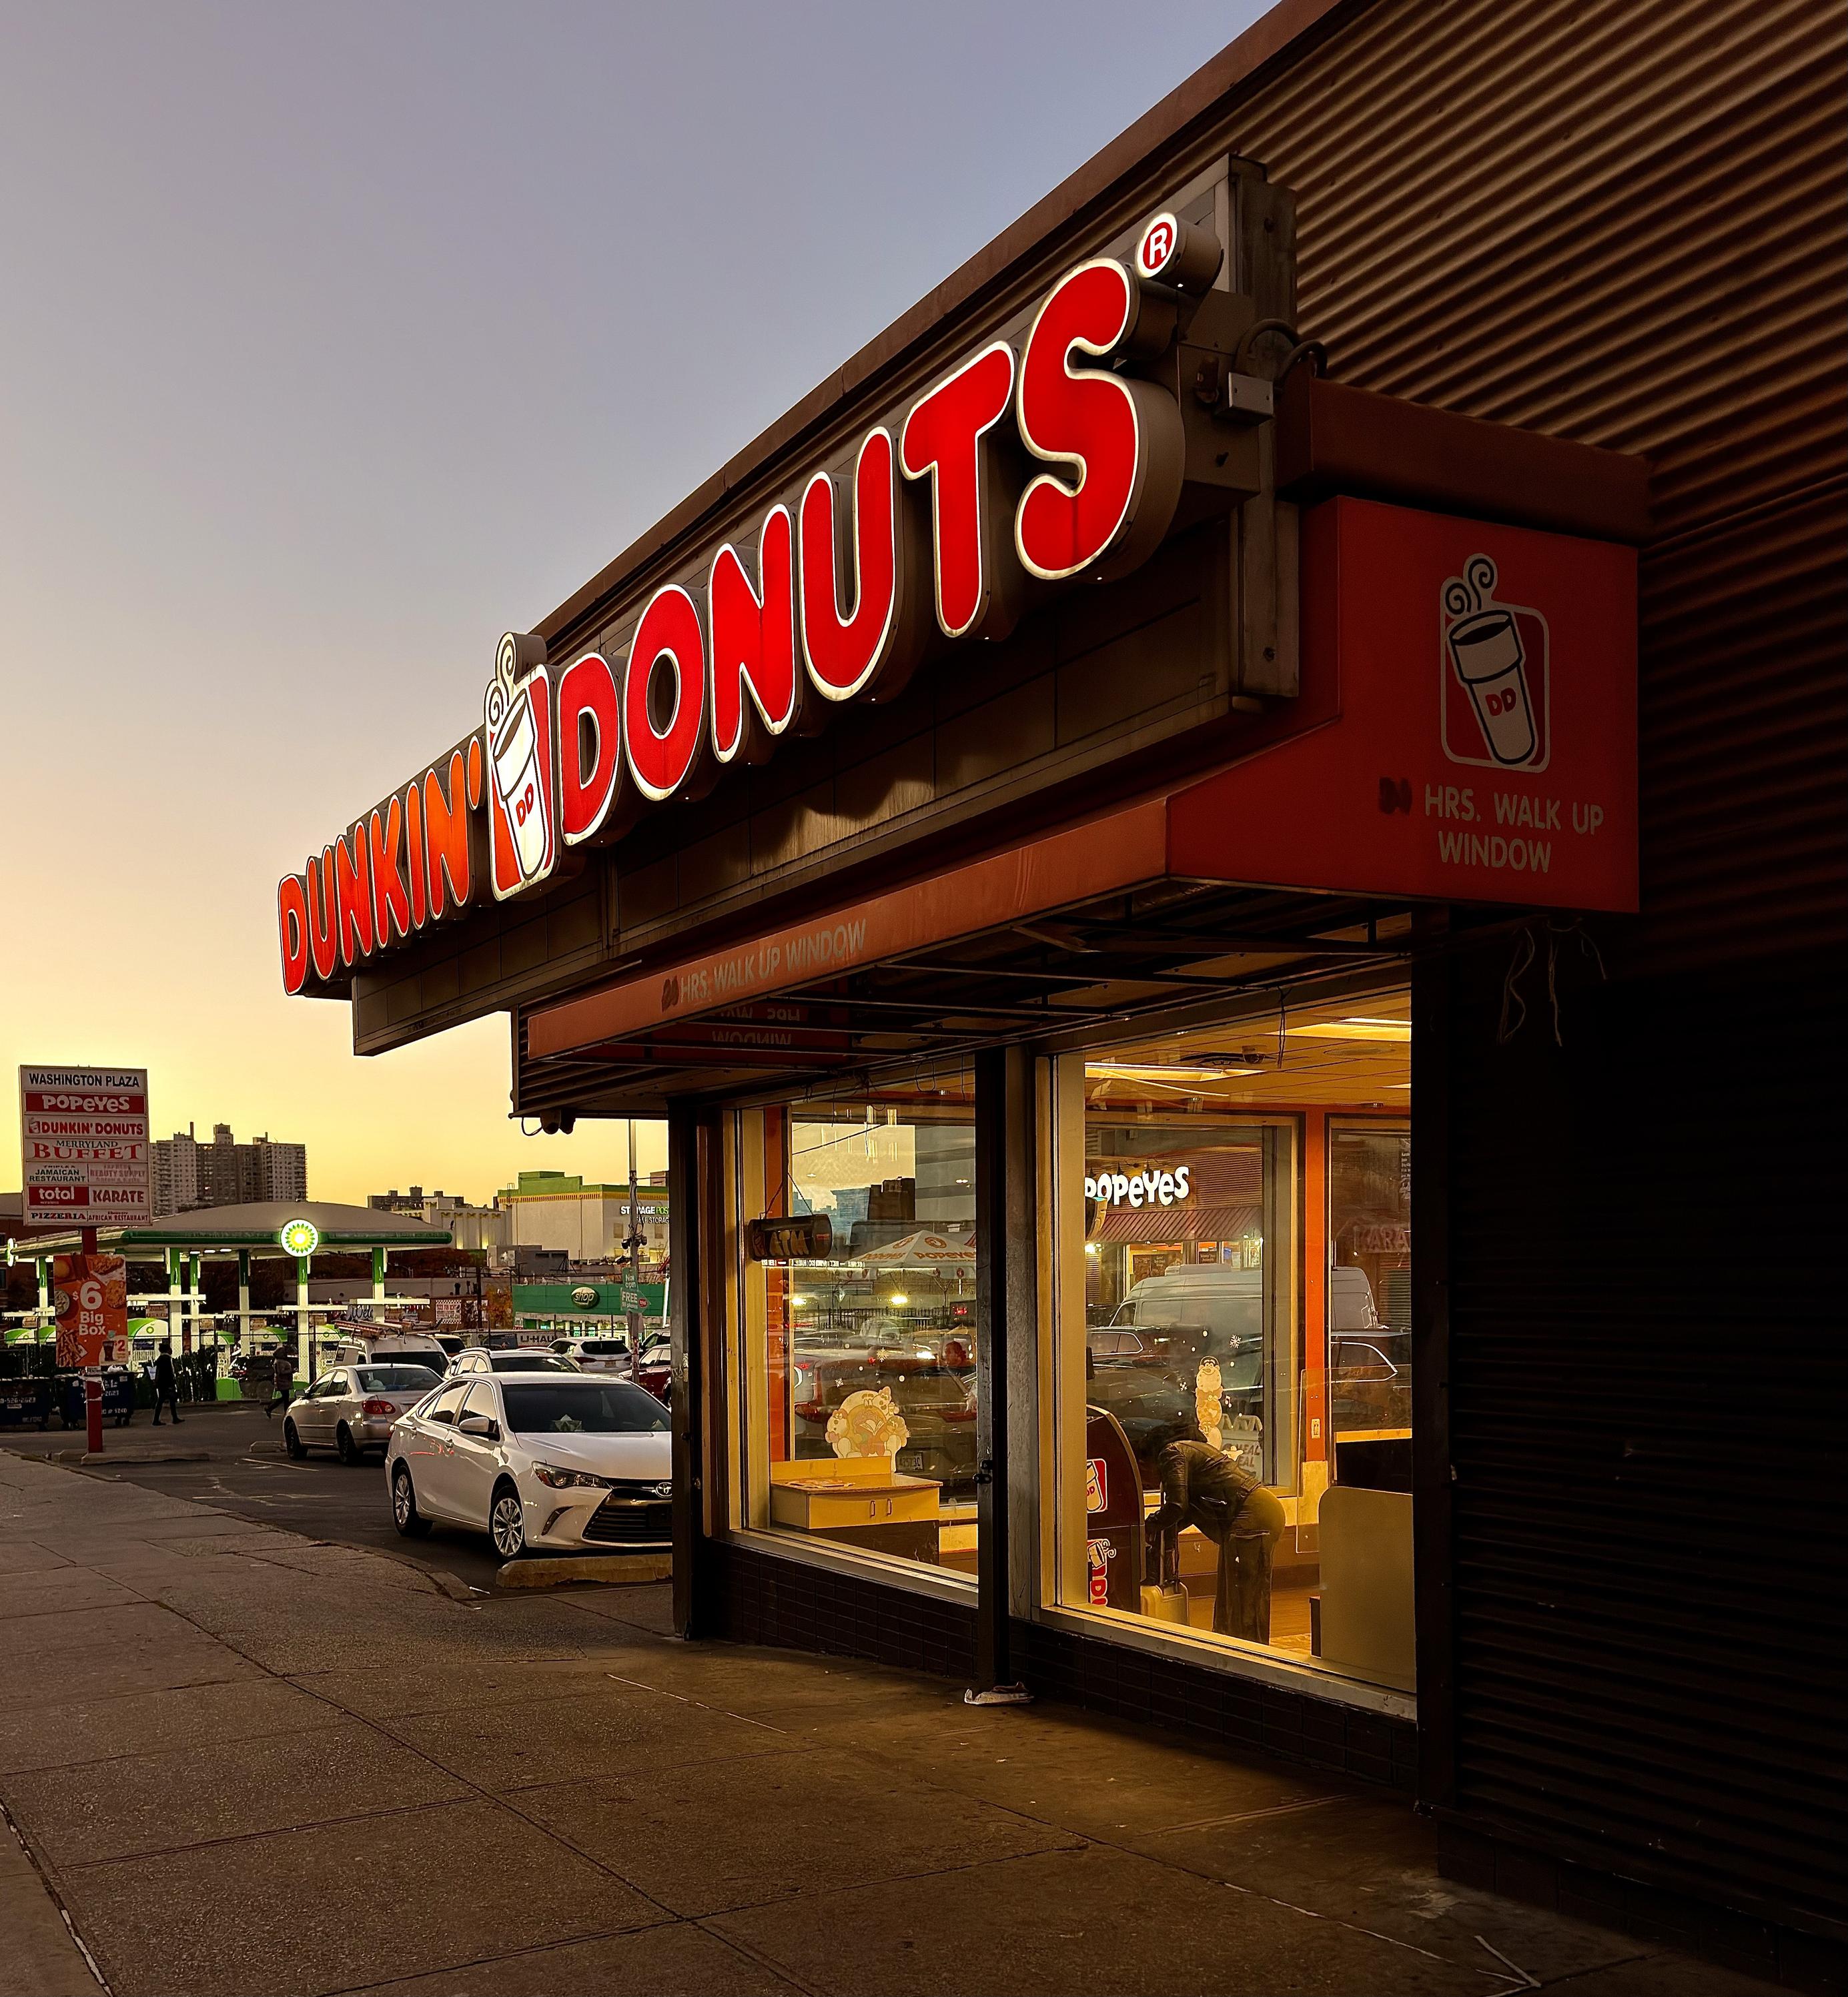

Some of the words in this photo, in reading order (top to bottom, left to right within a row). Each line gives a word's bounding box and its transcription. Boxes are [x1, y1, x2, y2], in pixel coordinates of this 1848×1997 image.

[278, 735, 482, 996] DUNKIN'
[558, 257, 1139, 846] DONUTS
[1486, 688, 1516, 716] DD
[516, 782, 534, 828] DD
[1424, 783, 1481, 822] HRS.
[1494, 792, 1561, 831] WALK
[1572, 802, 1604, 835] UP
[1438, 830, 1552, 873] WINDOW
[713, 954, 755, 994] WALK
[759, 946, 781, 979] UP
[785, 918, 867, 972] WINDOW
[29, 1073, 102, 1087] WASHINGTON
[105, 1075, 139, 1087] PLAZA
[41, 1121, 93, 1135] DUNKIN'
[95, 1122, 143, 1135] DONUTS
[32, 1141, 143, 1160] BUFFET
[56, 1139, 118, 1149] MERRYLAND
[39, 1185, 75, 1201] total
[92, 1189, 145, 1203] KARATE
[31, 1212, 87, 1220] PIZZERIA
[769, 1229, 809, 1256] ATM
[574, 1288, 594, 1305] shop
[622, 1291, 638, 1303] FREE
[79, 1311, 104, 1325] Big
[79, 1323, 106, 1335] Box
[520, 1335, 556, 1343] U-HAU
